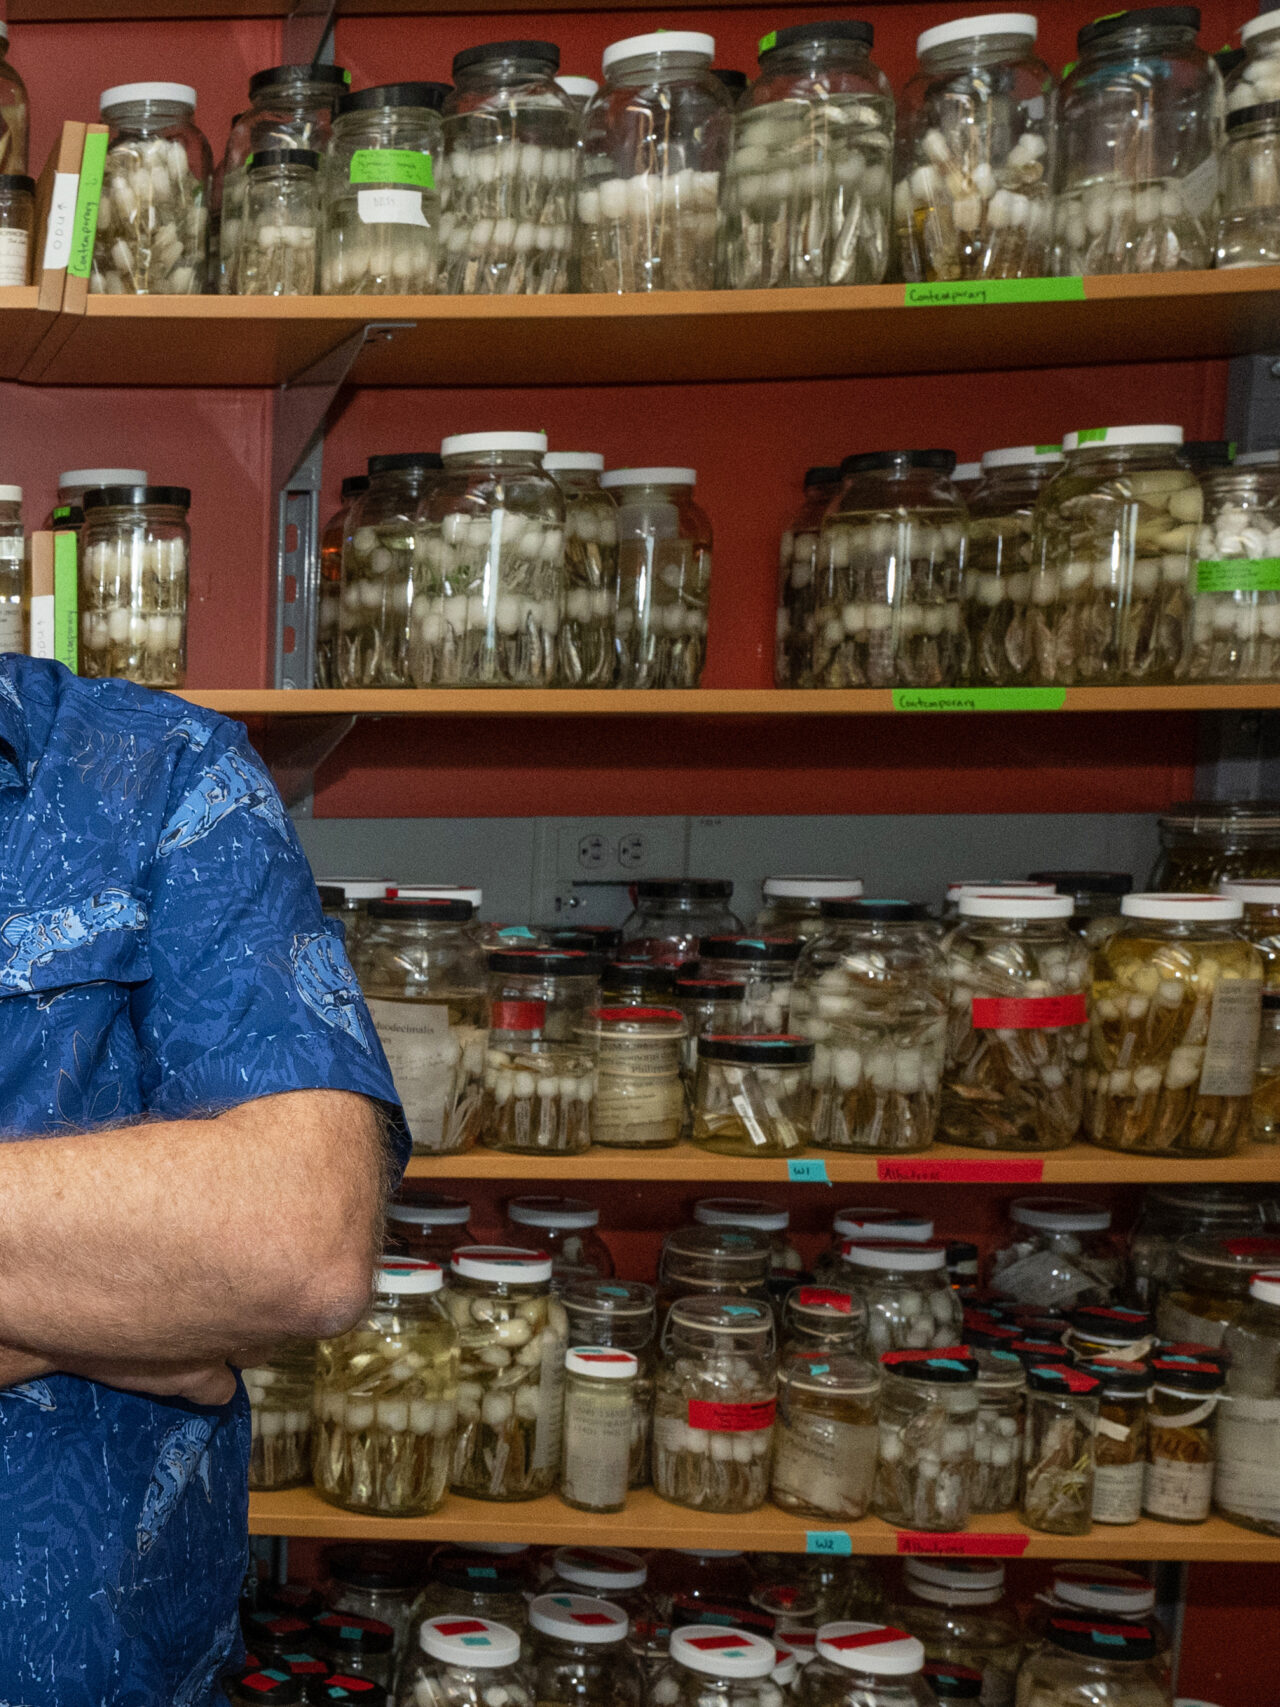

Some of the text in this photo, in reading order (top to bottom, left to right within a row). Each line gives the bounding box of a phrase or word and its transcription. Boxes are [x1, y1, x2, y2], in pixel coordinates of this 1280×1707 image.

[73, 200, 99, 272] Contemporary
[909, 289, 986, 303] Contemporary
[899, 694, 975, 709] Contemporary
